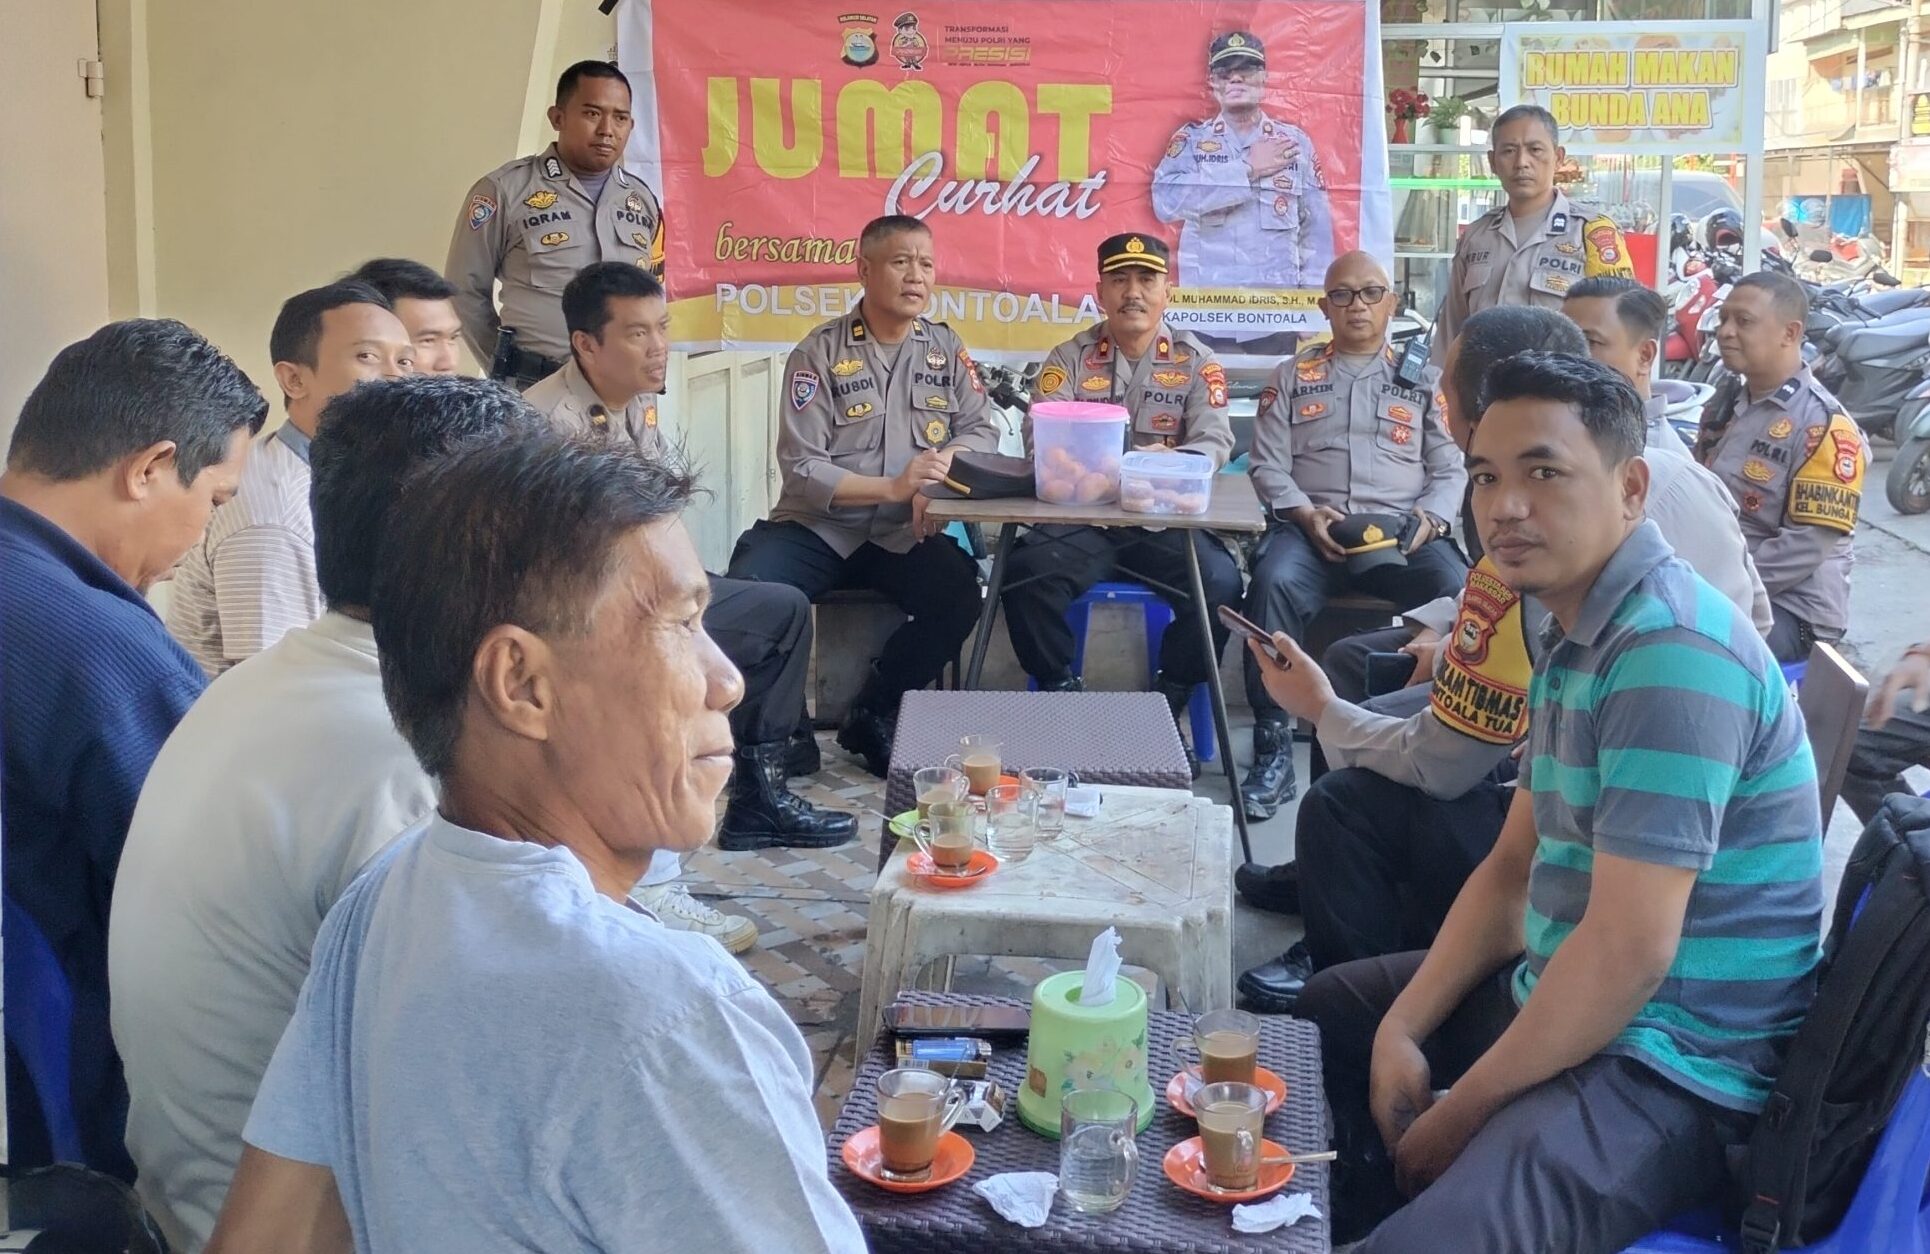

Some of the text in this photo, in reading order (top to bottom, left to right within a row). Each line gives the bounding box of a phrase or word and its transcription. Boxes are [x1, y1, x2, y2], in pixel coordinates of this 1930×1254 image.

[1008, 37, 1031, 45] YANG
[1525, 49, 1738, 87] RUMAH MAKAN
[1551, 91, 1711, 127] BUNDA ANA
[701, 76, 1113, 182] JUMAT
[884, 151, 1107, 221] Curhat
[523, 210, 573, 230] IQRAM
[715, 221, 856, 265] bersama
[1539, 257, 1582, 275] POLRI
[716, 283, 1105, 326] POLSEK ONTOALA
[1182, 295, 1246, 305] MUHAMMAD
[1248, 295, 1280, 305] IDRIS,
[1163, 312, 1308, 324] KAPOLSEK BONTOALA
[914, 373, 955, 387] POLRI
[1293, 384, 1334, 398] ARMIN
[1381, 383, 1424, 404] POLRI
[1750, 439, 1788, 463] POLRI
[1816, 505, 1850, 519] BUNGA
[1485, 713, 1514, 734] TUA
